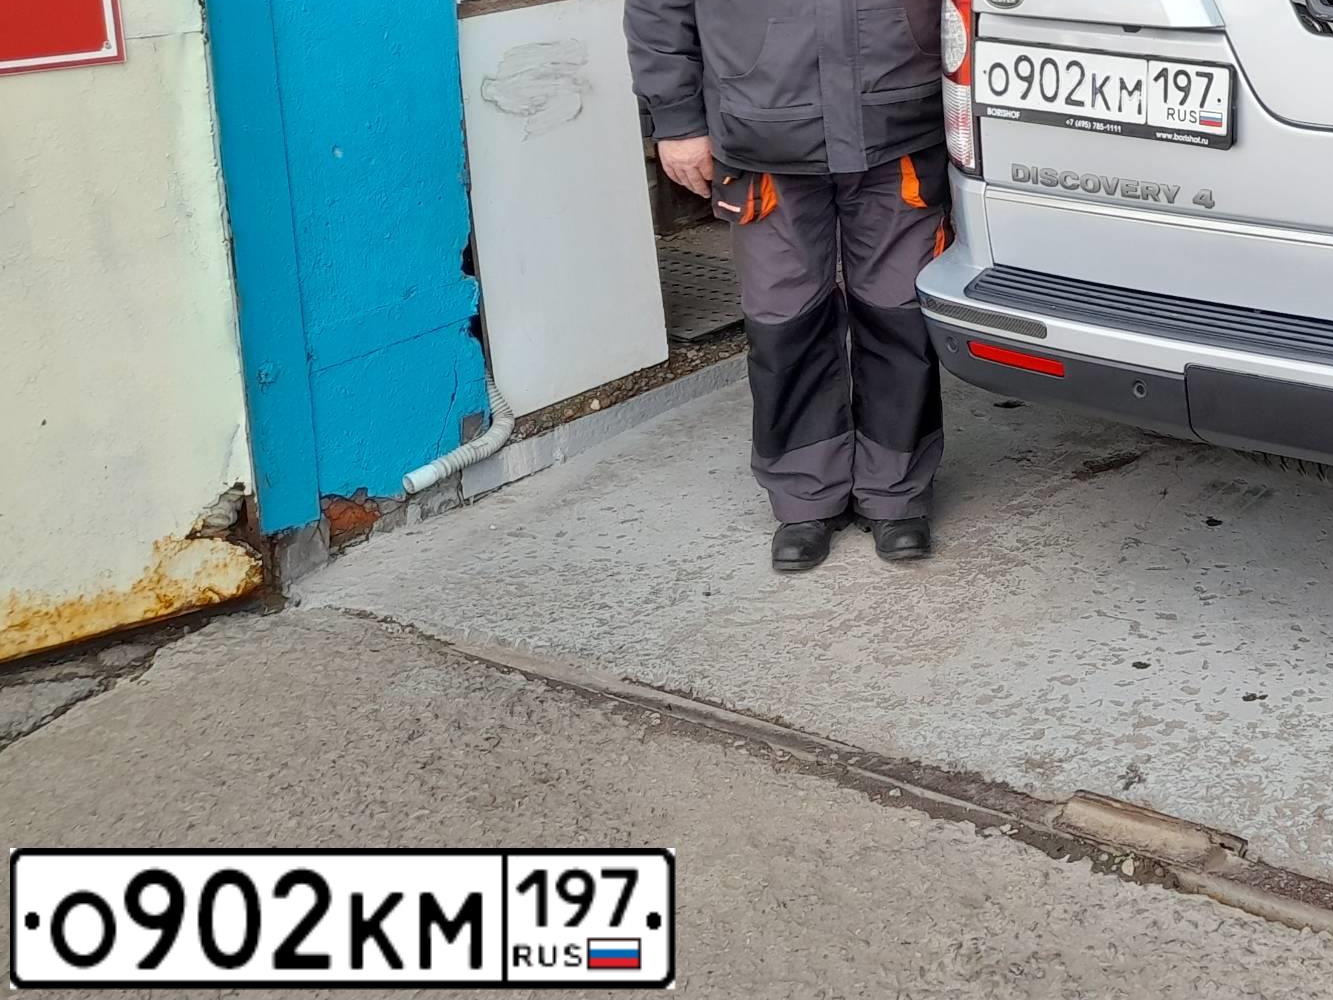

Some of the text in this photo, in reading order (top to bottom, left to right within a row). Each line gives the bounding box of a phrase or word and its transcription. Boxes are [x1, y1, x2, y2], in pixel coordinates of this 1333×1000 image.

[1153, 67, 1214, 108] 197
[1166, 108, 1198, 123] RUS
[1011, 163, 1216, 208] DISCOVERY 4
